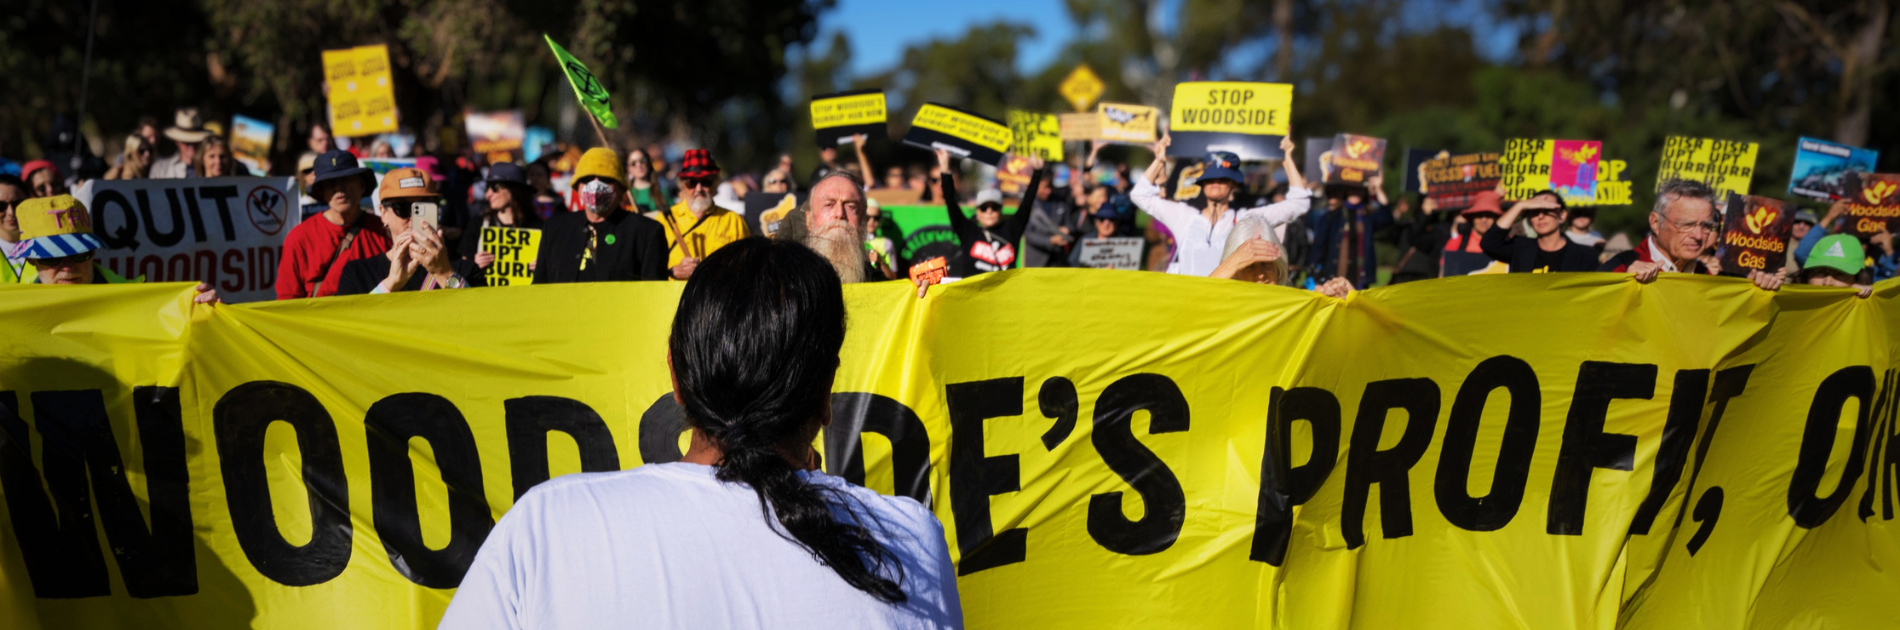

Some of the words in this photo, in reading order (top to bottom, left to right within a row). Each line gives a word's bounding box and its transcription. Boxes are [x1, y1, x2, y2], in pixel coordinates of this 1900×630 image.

[1208, 89, 1254, 105] STOP
[1181, 108, 1278, 126] WOODSIDE
[1508, 139, 1546, 151] DISR
[1667, 137, 1704, 151] DISR
[1712, 141, 1750, 154] DISR
[1507, 152, 1537, 164] UPT
[1665, 148, 1695, 161] UPT
[1709, 152, 1742, 164] UPT
[1504, 164, 1550, 176] BURR
[1596, 160, 1627, 181] OP
[1662, 160, 1706, 173] BURR
[1707, 162, 1751, 178] BURR
[1427, 166, 1465, 184] FOSSI
[1503, 176, 1526, 187] UP
[1502, 188, 1538, 200] HUB
[1847, 202, 1900, 217] Woodsid
[92, 185, 240, 252] QUIT
[1857, 217, 1887, 232] Gas
[483, 228, 531, 246] DISR
[1725, 230, 1785, 253] Woodside
[901, 230, 962, 261] GREENWAS
[1738, 251, 1766, 270] Gas
[92, 246, 284, 293] OODSID
[490, 277, 510, 287] P
[0, 373, 1190, 598] WOODDE'S
[1249, 354, 1756, 566] PROFIT,
